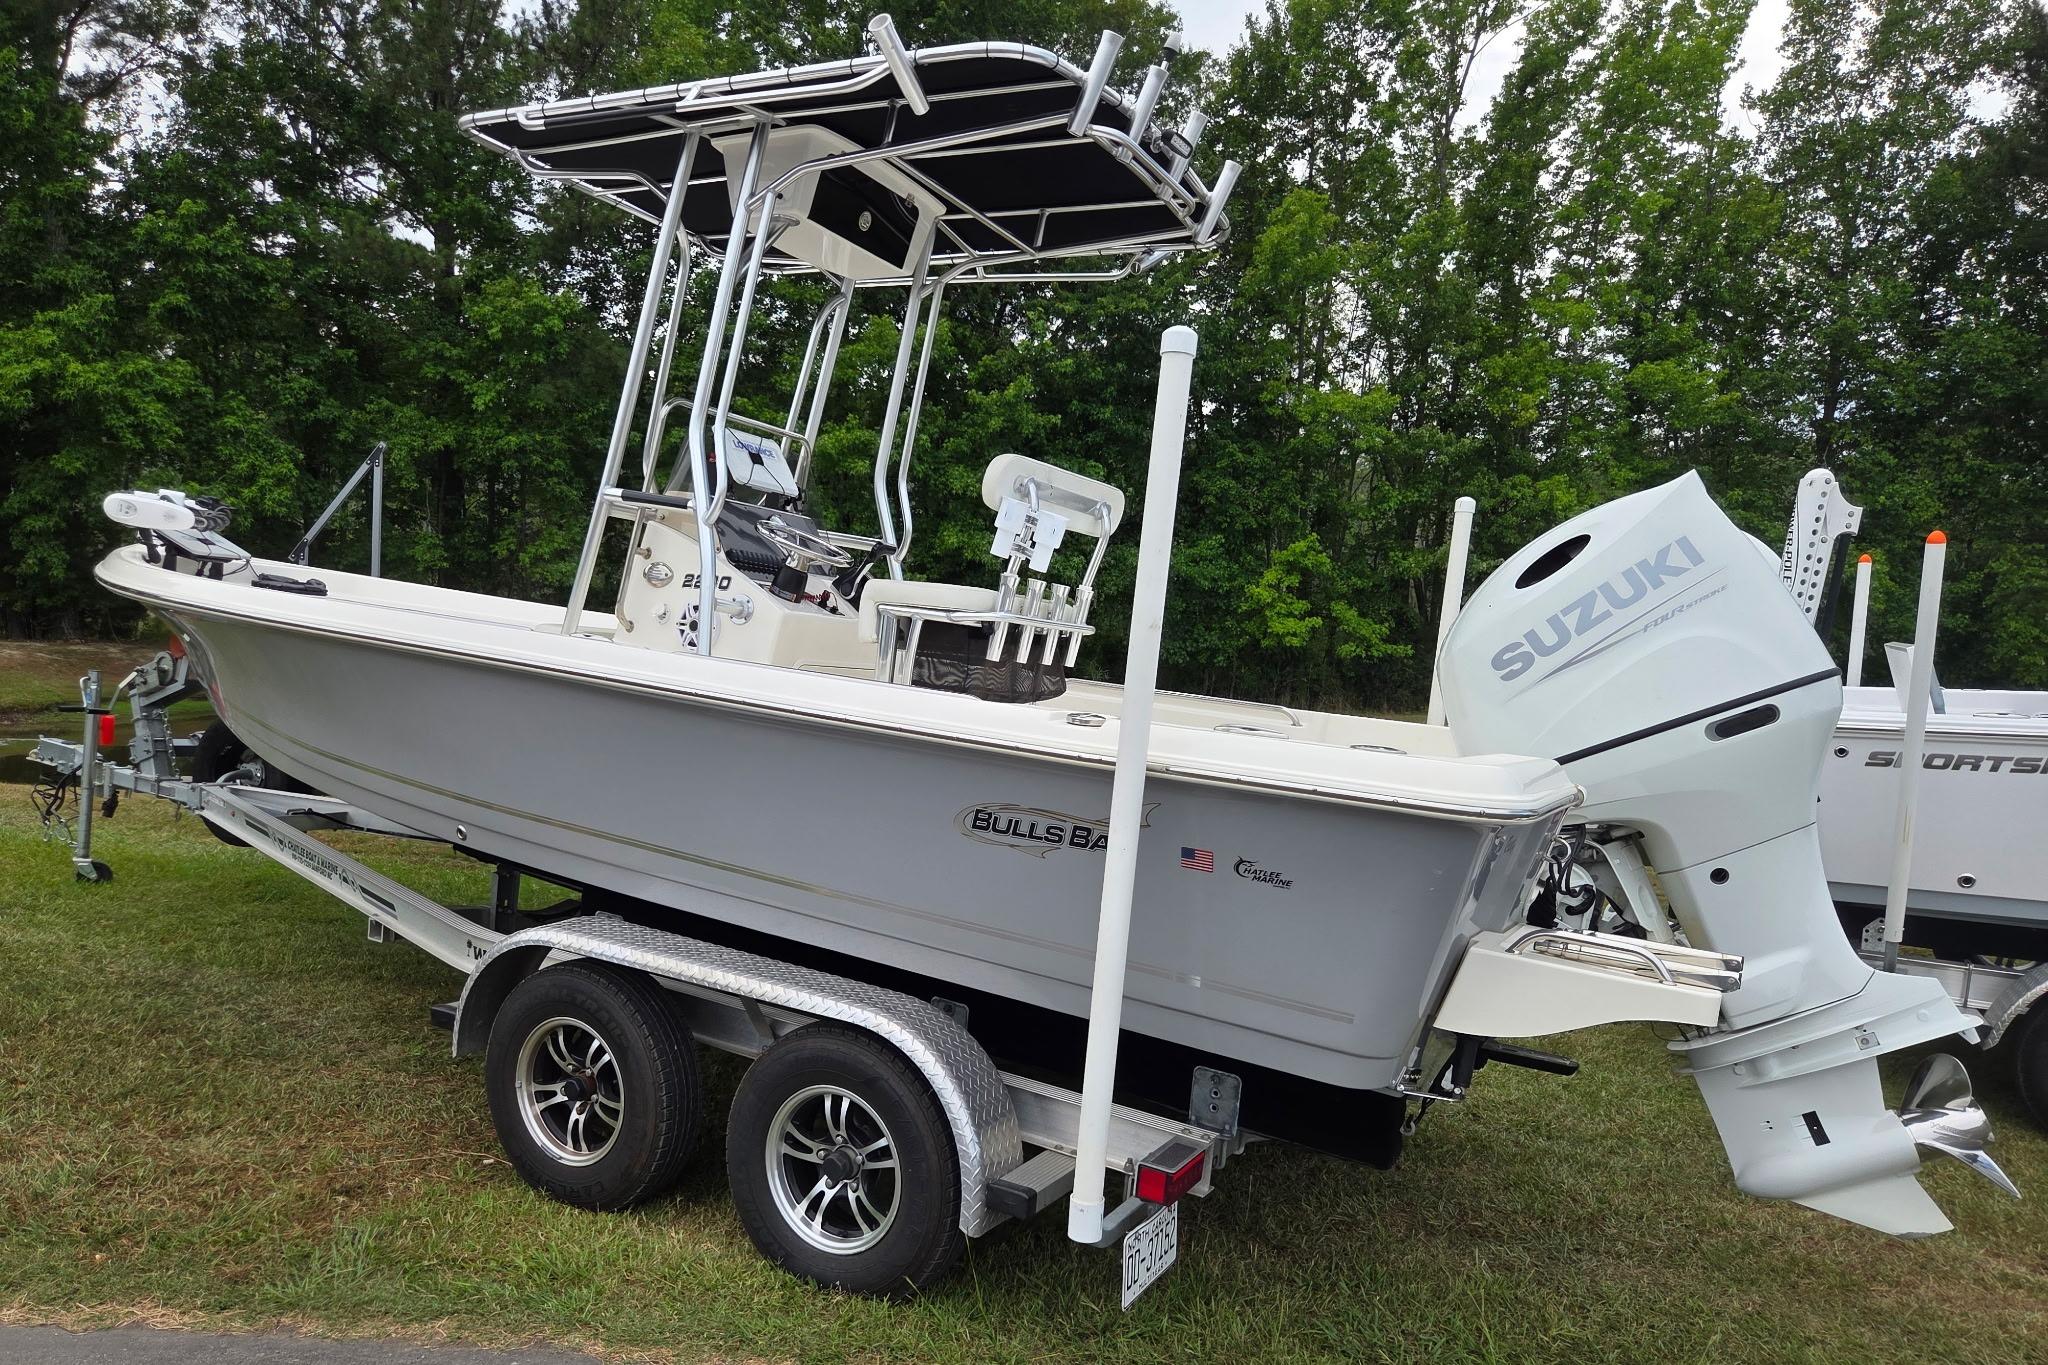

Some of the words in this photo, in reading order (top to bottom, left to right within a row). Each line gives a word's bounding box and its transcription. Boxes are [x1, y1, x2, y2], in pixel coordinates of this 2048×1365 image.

[682, 573, 732, 591] 220
[1490, 535, 1705, 682] SUZUKI
[1864, 751, 2048, 775] SORTS
[972, 808, 1065, 845] BULLS
[1068, 823, 1109, 852] BA
[1251, 875, 1293, 887] MARINE
[1128, 1230, 1149, 1253] NORTH
